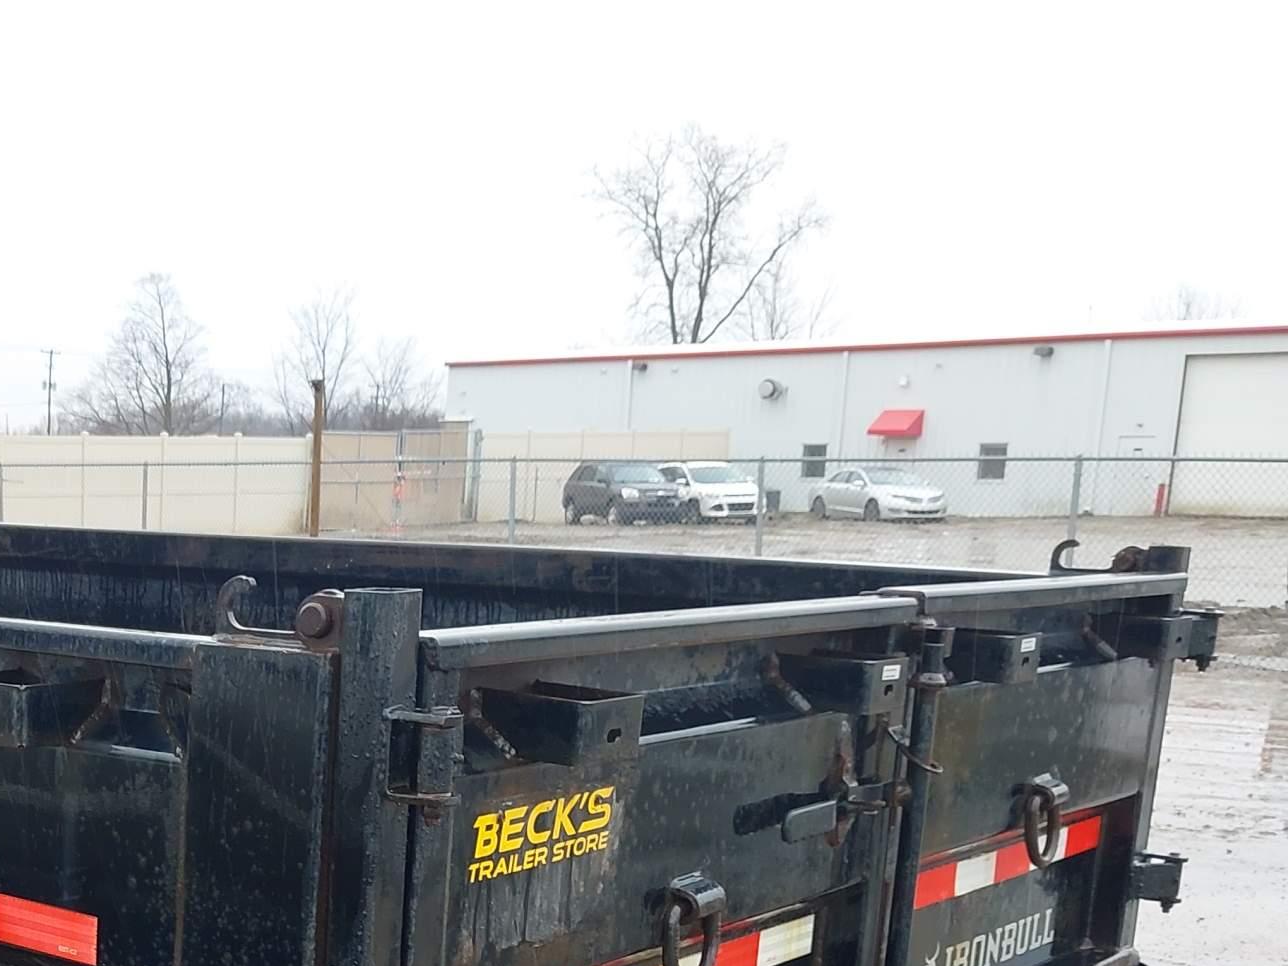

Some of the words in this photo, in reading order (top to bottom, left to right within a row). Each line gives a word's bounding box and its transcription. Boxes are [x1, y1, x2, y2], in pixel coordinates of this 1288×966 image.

[472, 786, 615, 859] BECK'S
[468, 846, 548, 884] TRAILER
[552, 831, 610, 863] STORE
